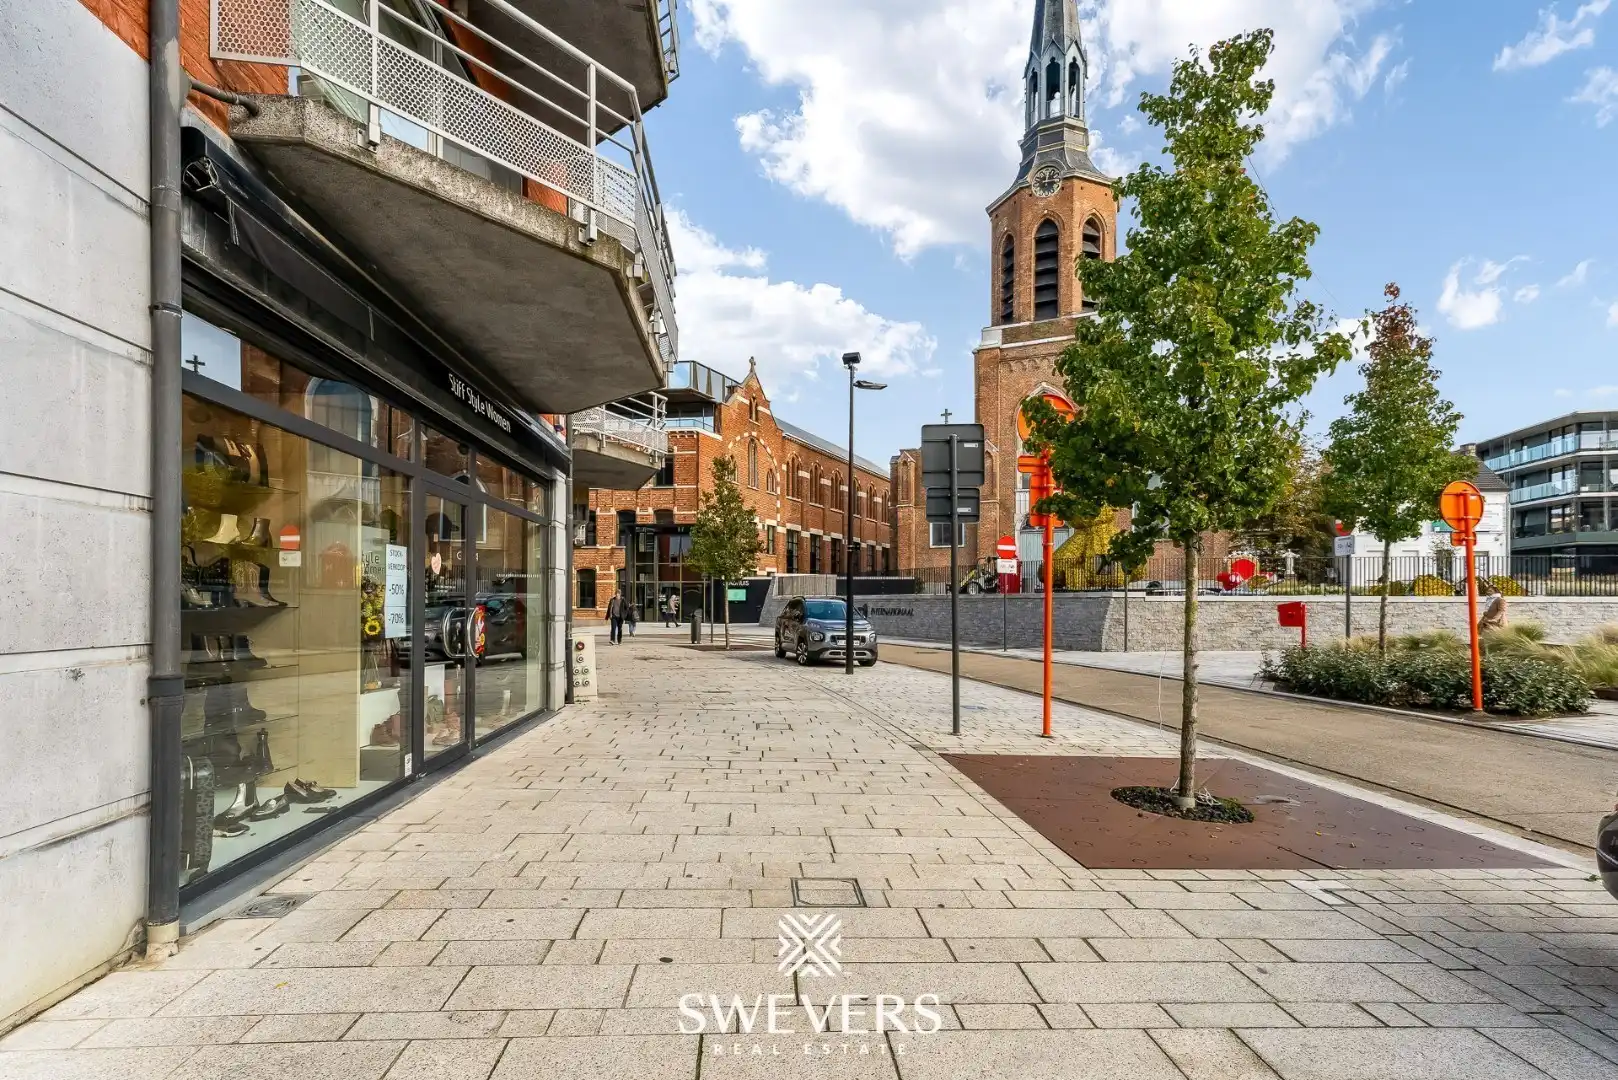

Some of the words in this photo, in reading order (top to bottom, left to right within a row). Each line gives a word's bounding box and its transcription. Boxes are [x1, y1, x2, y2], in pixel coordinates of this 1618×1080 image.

[466, 387, 486, 414] Style
[485, 401, 511, 433] Women
[388, 583, 405, 596] -50%
[388, 612, 405, 625] -70%
